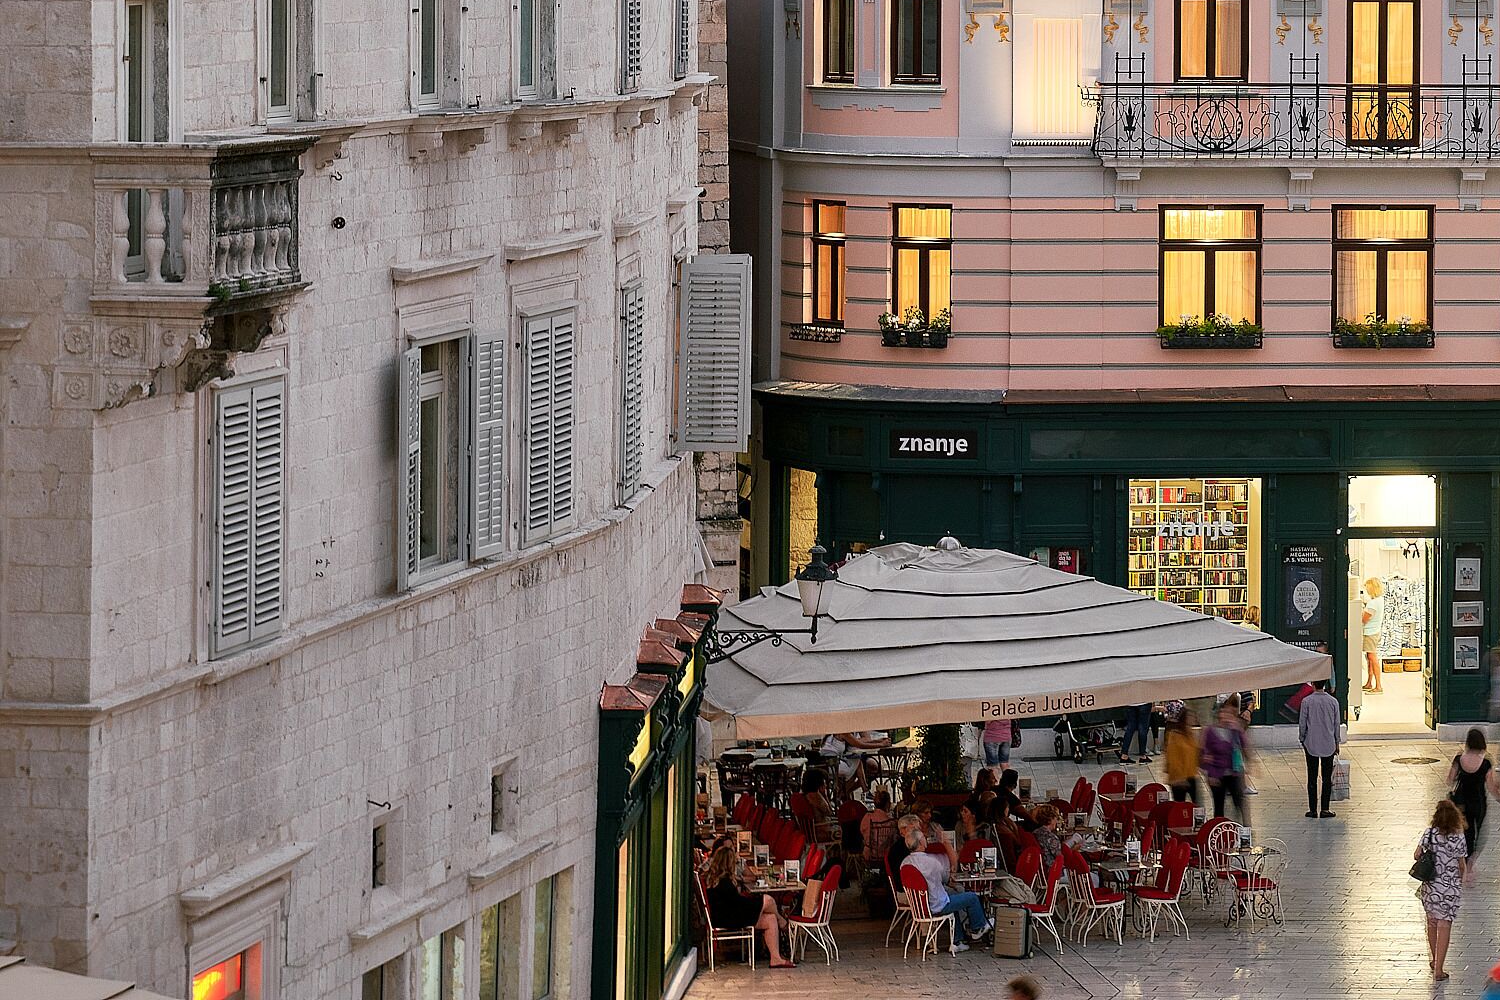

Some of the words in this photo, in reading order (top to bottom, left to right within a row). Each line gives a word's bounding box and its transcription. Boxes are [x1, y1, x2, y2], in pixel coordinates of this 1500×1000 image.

[899, 437, 968, 456] znanje
[1157, 520, 1235, 541] znanje
[980, 696, 1036, 718] Palača
[1042, 692, 1096, 712] Judita
